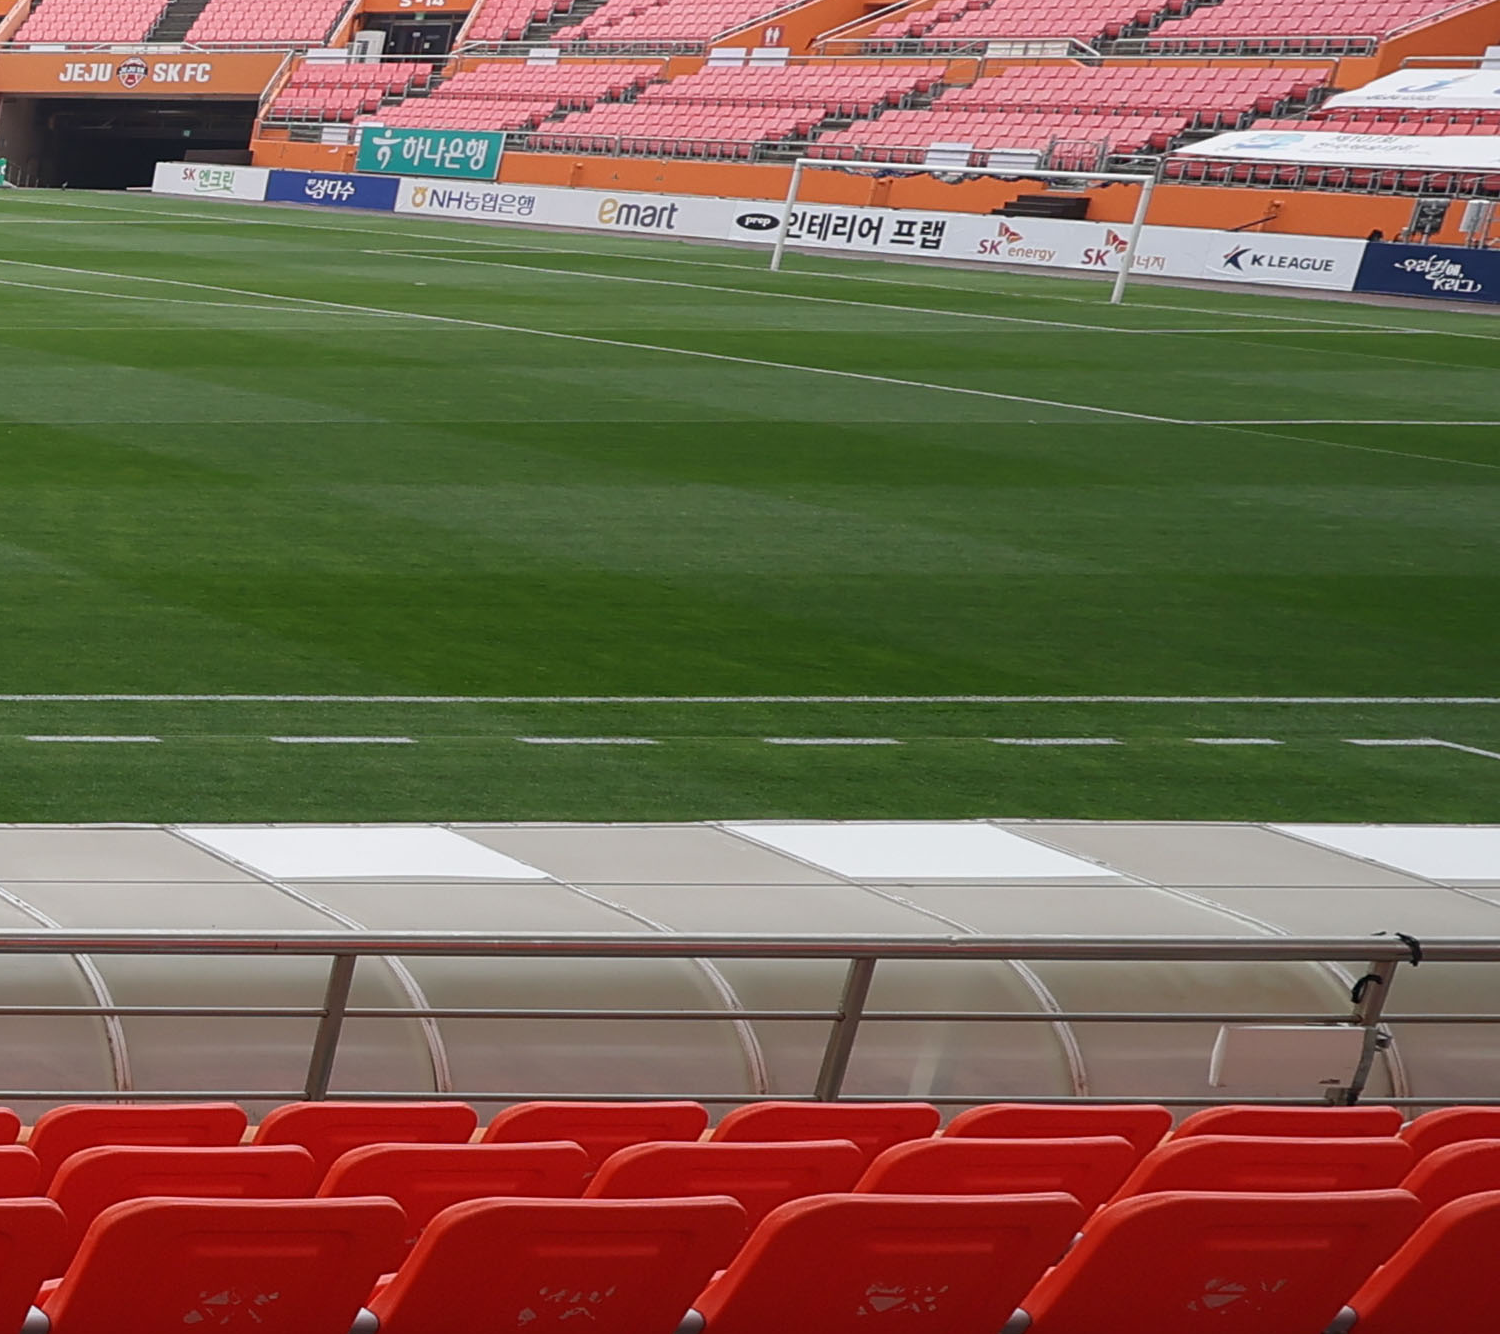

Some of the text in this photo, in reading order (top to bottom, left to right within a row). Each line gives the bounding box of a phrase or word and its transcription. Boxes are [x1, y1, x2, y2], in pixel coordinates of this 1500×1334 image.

[59, 63, 211, 83] JEJU SK FC
[403, 134, 489, 171] 하나은행
[182, 167, 195, 181] SK
[305, 178, 356, 202] 삼다수
[428, 189, 536, 216] NH농협은행
[598, 197, 679, 230] emart
[783, 210, 884, 246] 인테리어
[889, 218, 947, 251] 프랩
[976, 238, 1056, 262] SK energy
[1081, 247, 1111, 267] SK
[1250, 253, 1335, 272] K LEAGUE
